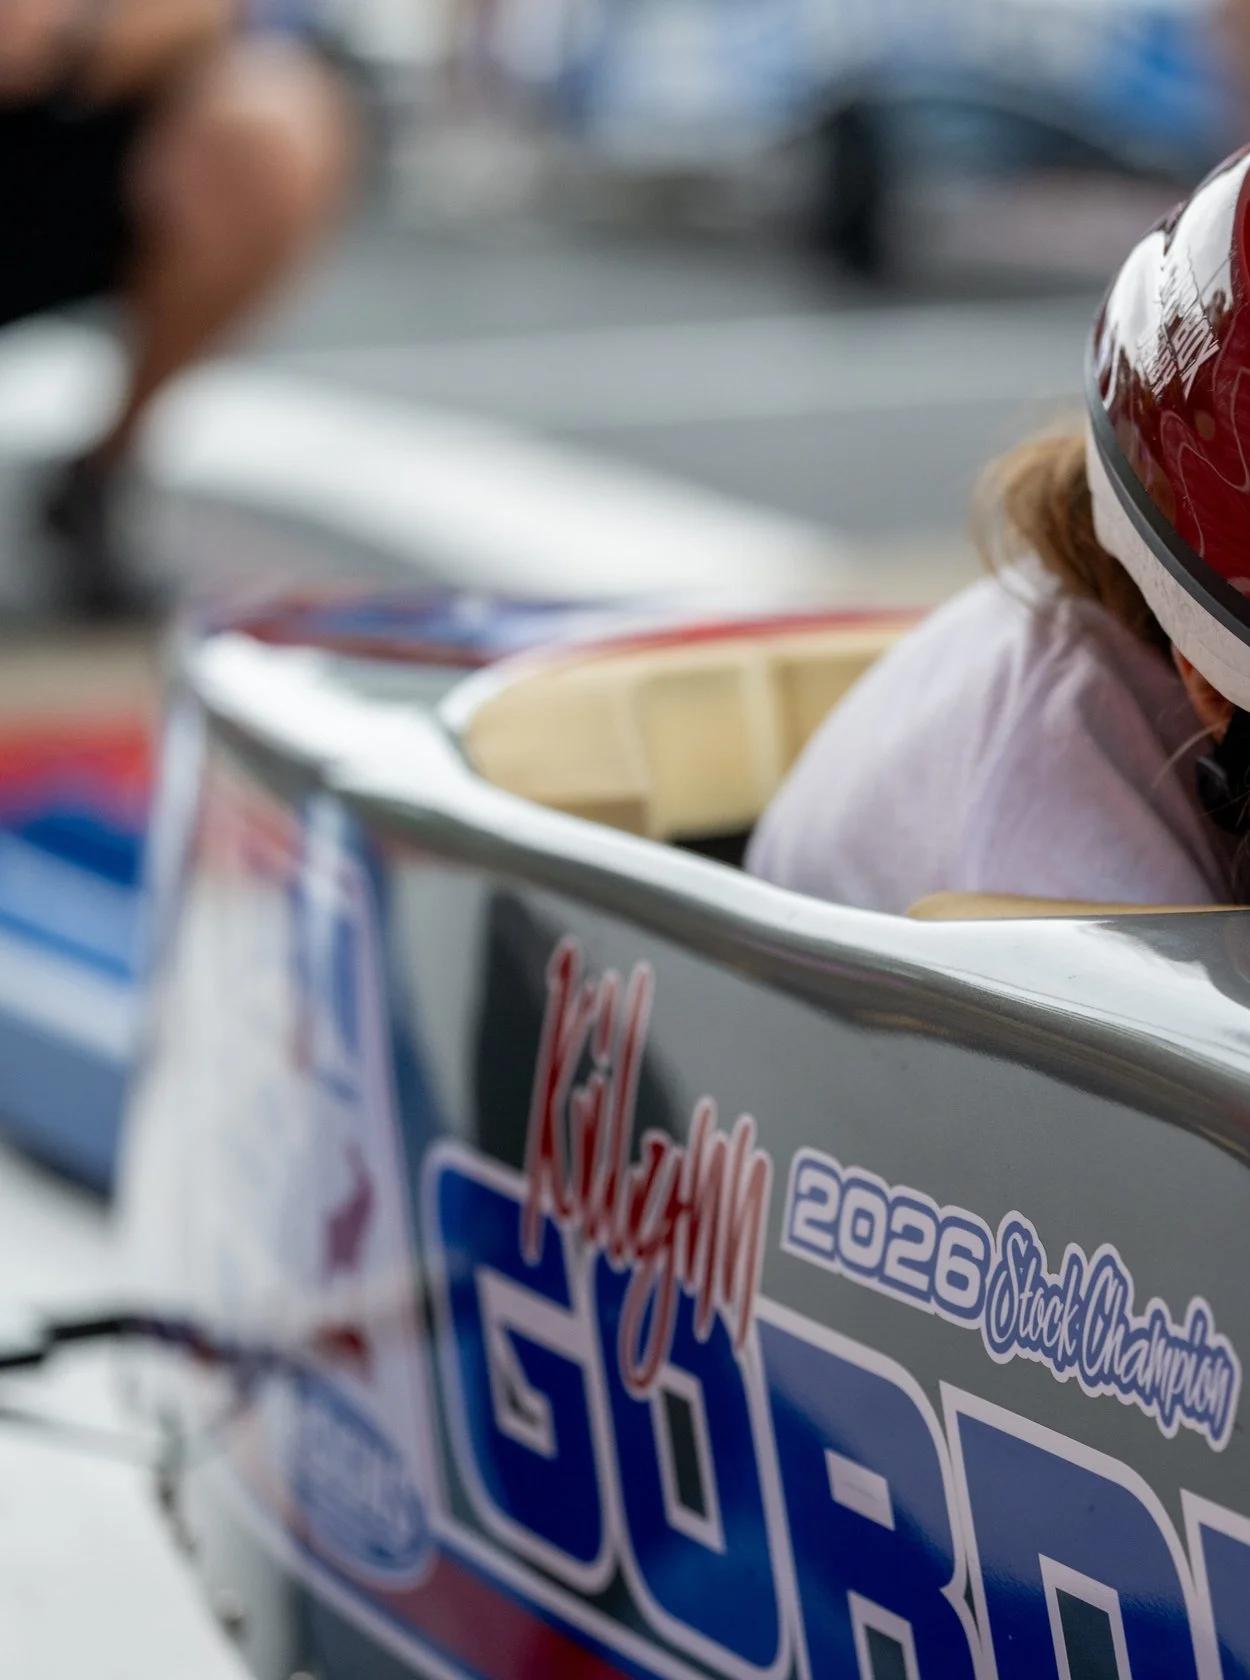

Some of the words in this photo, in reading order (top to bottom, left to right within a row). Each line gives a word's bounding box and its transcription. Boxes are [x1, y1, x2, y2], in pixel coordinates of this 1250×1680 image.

[1171, 304, 1220, 399] BOX
[788, 1154, 991, 1322] 2026
[986, 1226, 1081, 1366] Stock
[1081, 1258, 1234, 1430] Champion
